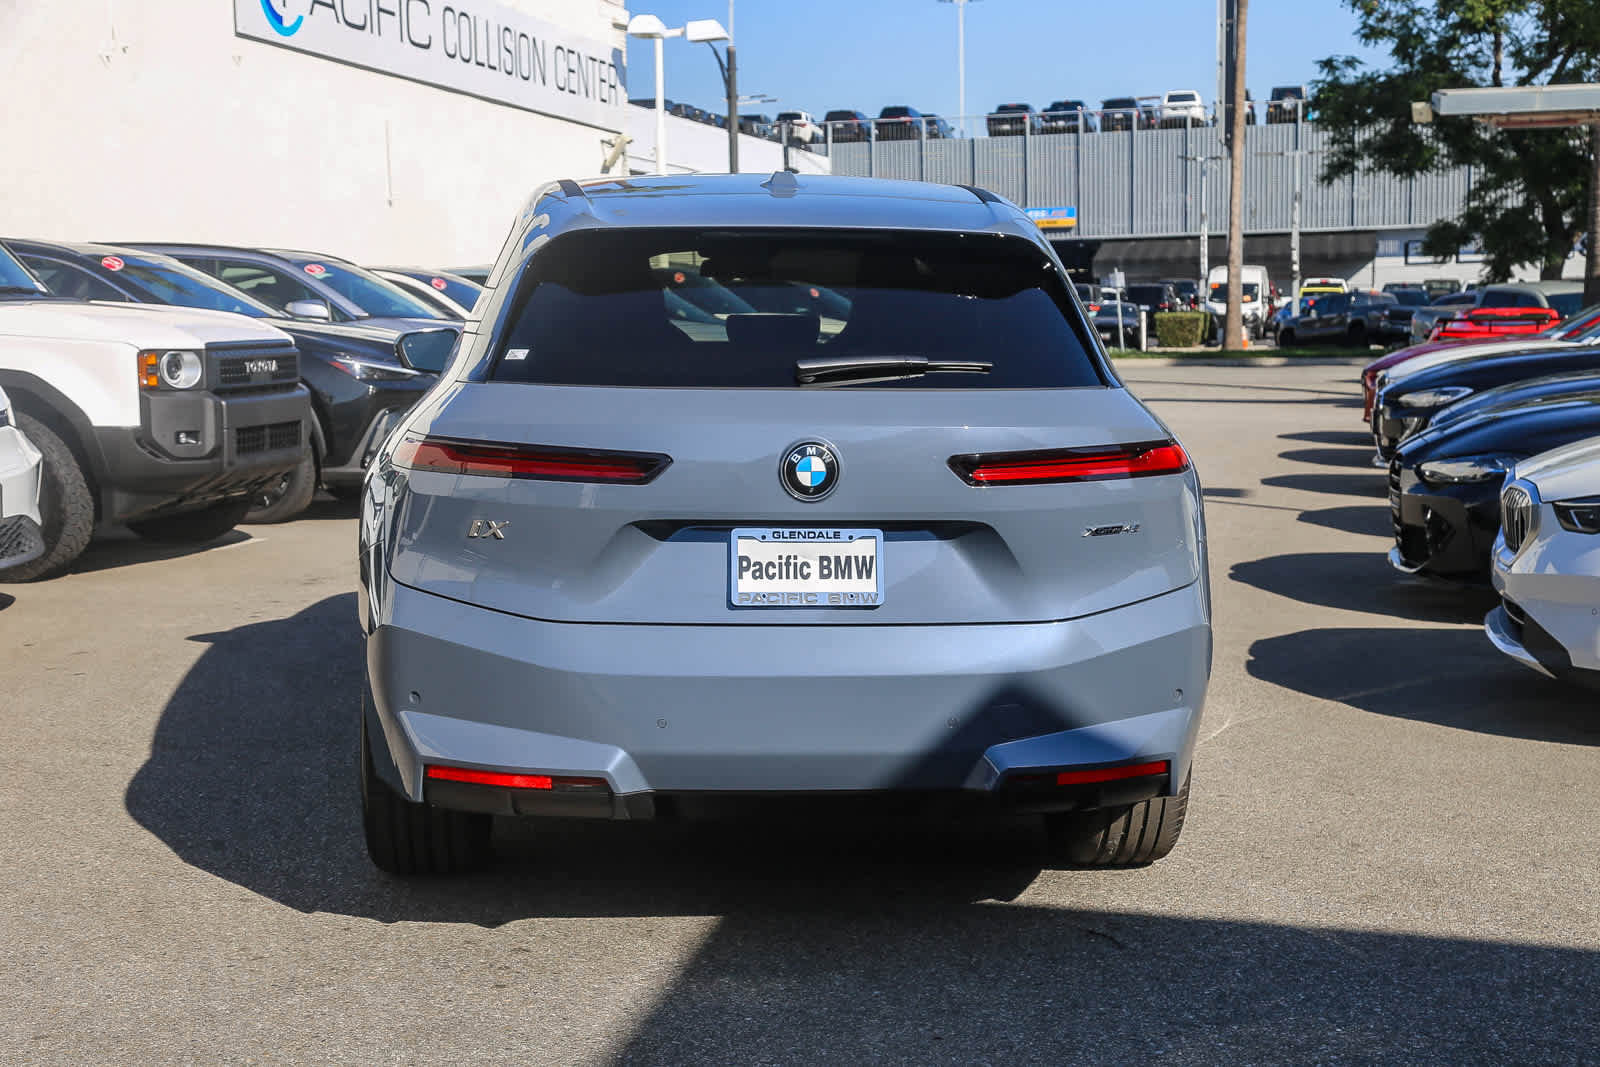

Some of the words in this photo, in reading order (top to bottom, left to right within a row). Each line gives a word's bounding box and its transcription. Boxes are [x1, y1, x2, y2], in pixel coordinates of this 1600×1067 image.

[442, 6, 546, 86] COLLISION
[554, 45, 618, 106] CENTER
[244, 360, 279, 372] TOYOTA
[791, 446, 833, 464] BMW
[772, 531, 841, 540] GLENDALE
[738, 555, 811, 580] Pacific
[818, 555, 874, 580] BMW
[738, 592, 818, 604] PACIFIC
[828, 592, 878, 604] BMW
